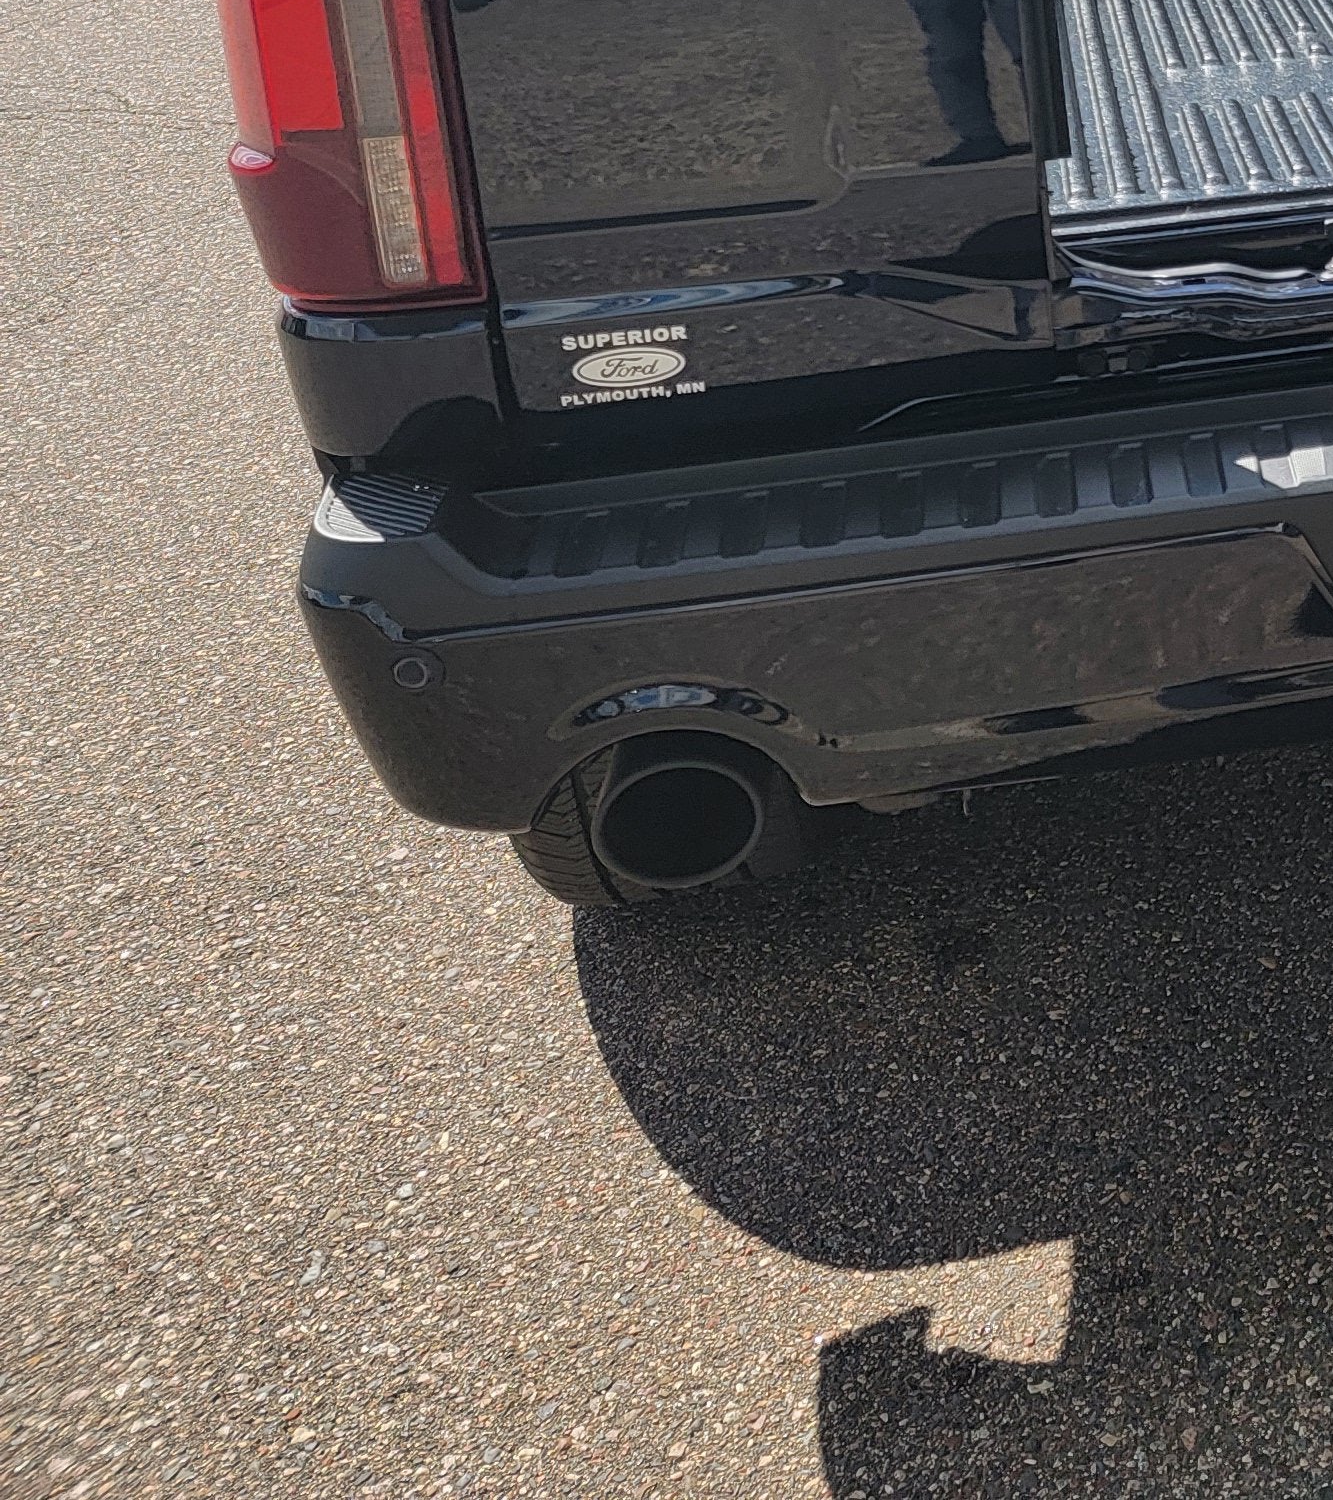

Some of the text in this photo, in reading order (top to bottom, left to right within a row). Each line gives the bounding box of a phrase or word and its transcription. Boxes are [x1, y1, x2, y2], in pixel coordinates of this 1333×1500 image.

[561, 325, 688, 351] SUPERIOR
[600, 357, 659, 379] Ford
[560, 381, 706, 407] PLYMOUTH, MN
